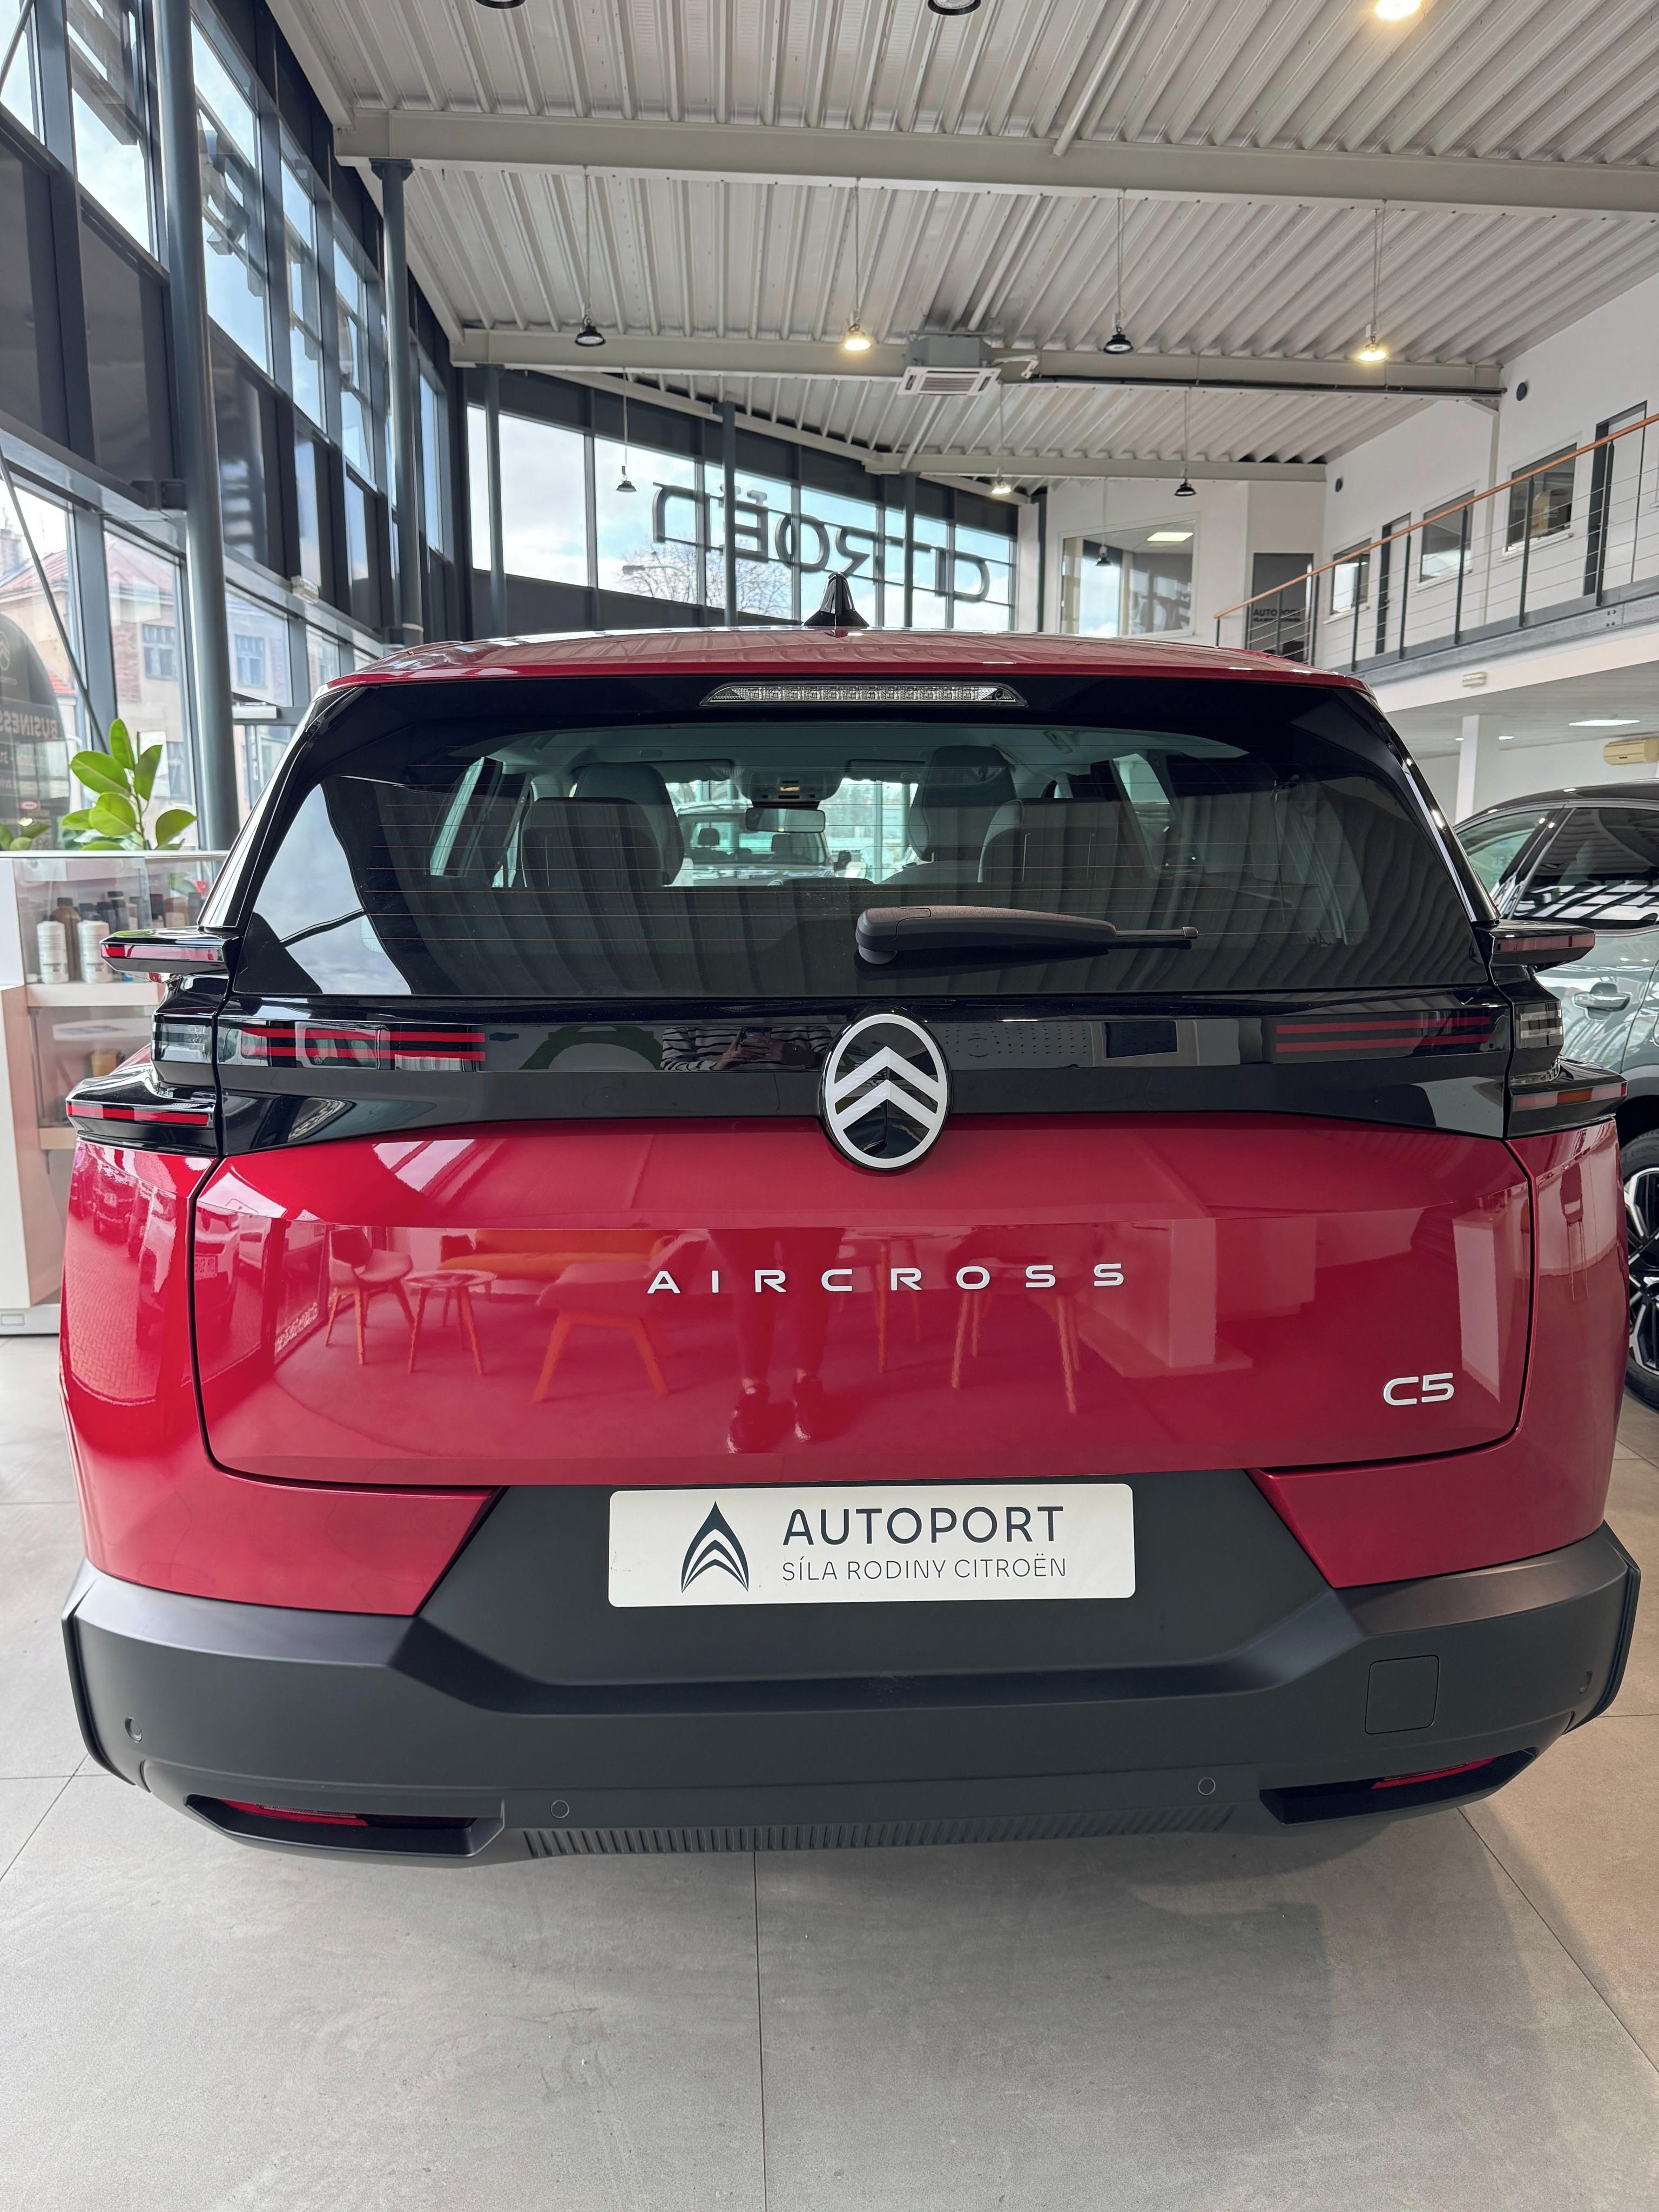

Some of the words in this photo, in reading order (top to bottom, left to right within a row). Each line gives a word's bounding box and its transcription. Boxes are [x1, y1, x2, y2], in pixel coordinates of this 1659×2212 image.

[647, 1263, 1124, 1294] AIRCROSS
[1383, 1372, 1454, 1406] C5
[783, 1506, 1063, 1546] AUTOPORT
[782, 1556, 838, 1581] SÍLA
[847, 1559, 946, 1580] RODINY
[954, 1553, 1065, 1579] CITROËN
